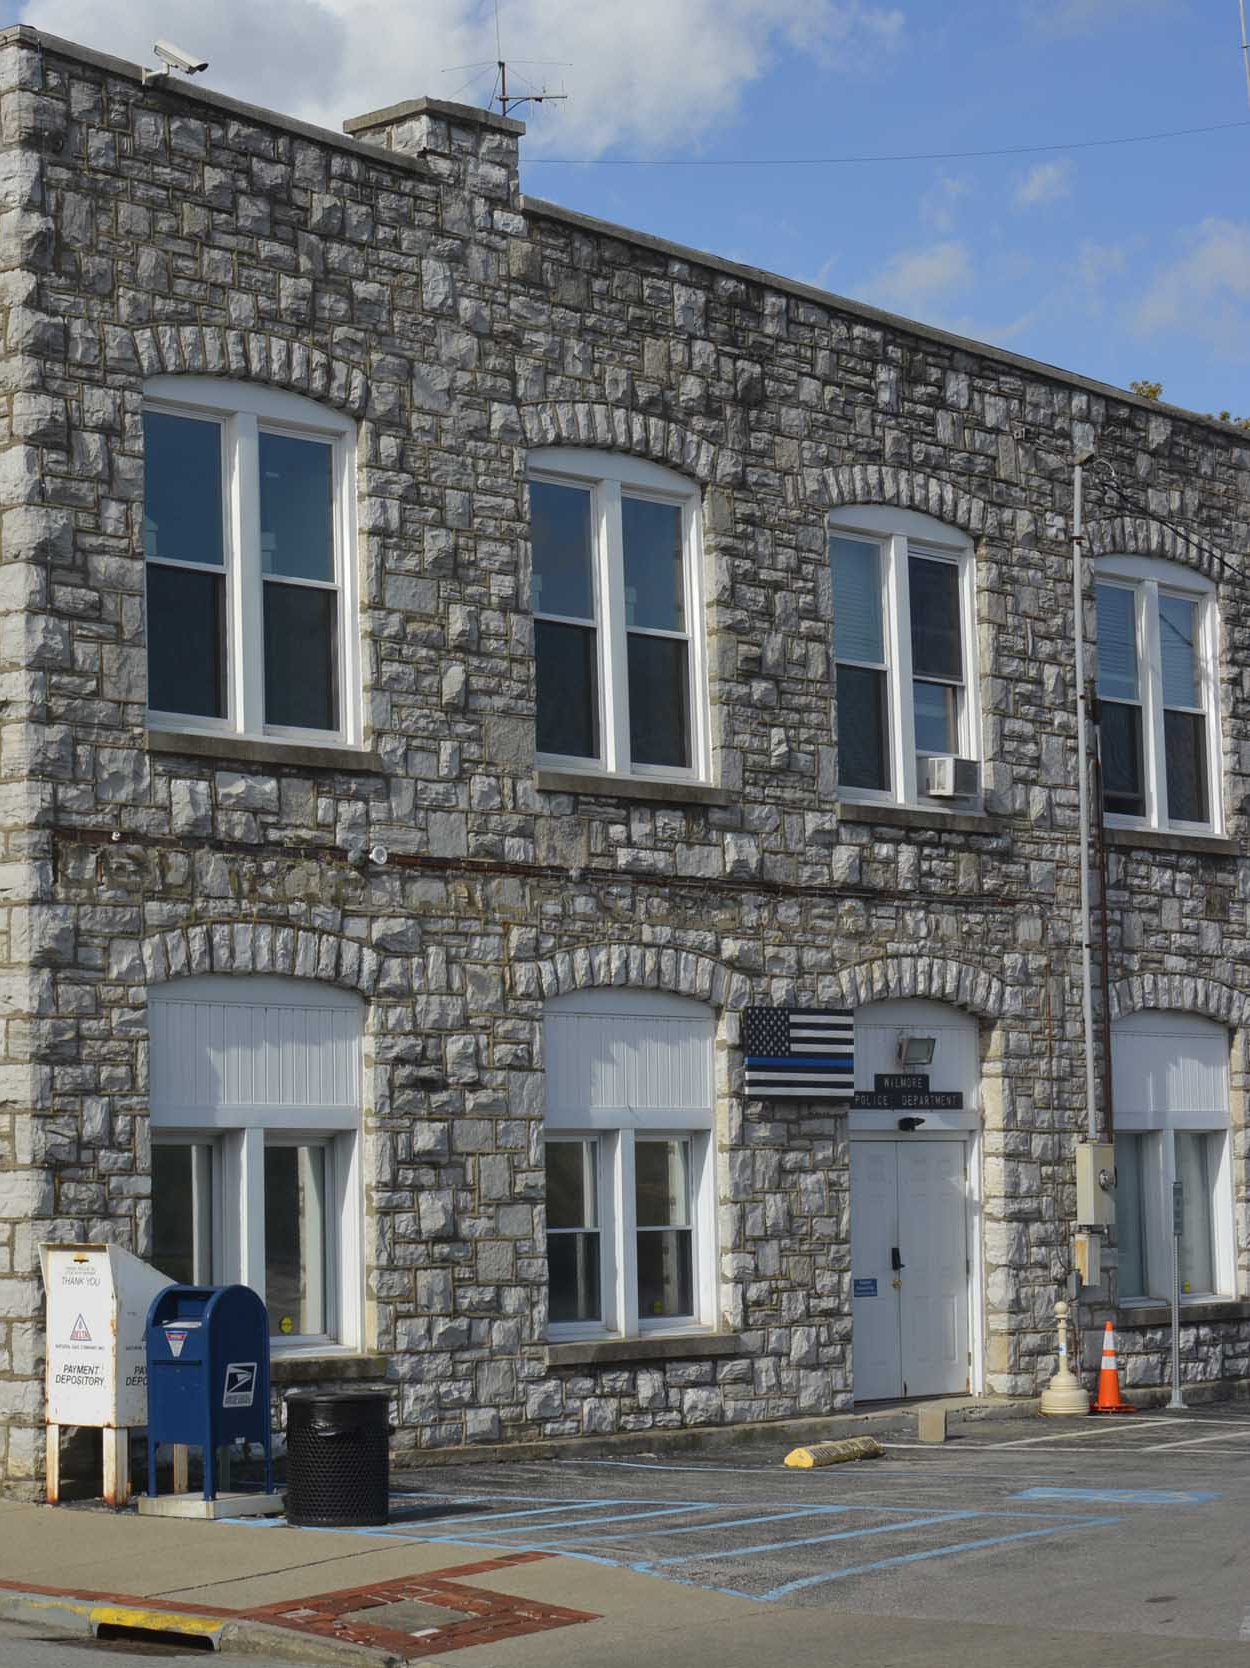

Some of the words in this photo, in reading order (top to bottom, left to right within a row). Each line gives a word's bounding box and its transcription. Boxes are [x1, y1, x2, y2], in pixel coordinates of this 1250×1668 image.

[883, 1077, 924, 1089] WILMORE
[855, 1095, 888, 1106] POLICE
[901, 1095, 958, 1106] DEPARTMENT
[62, 1276, 85, 1287] THANK
[85, 1276, 101, 1287] YOU
[63, 1364, 100, 1375] PAYMENT
[55, 1374, 105, 1386] DEPOSITORY
